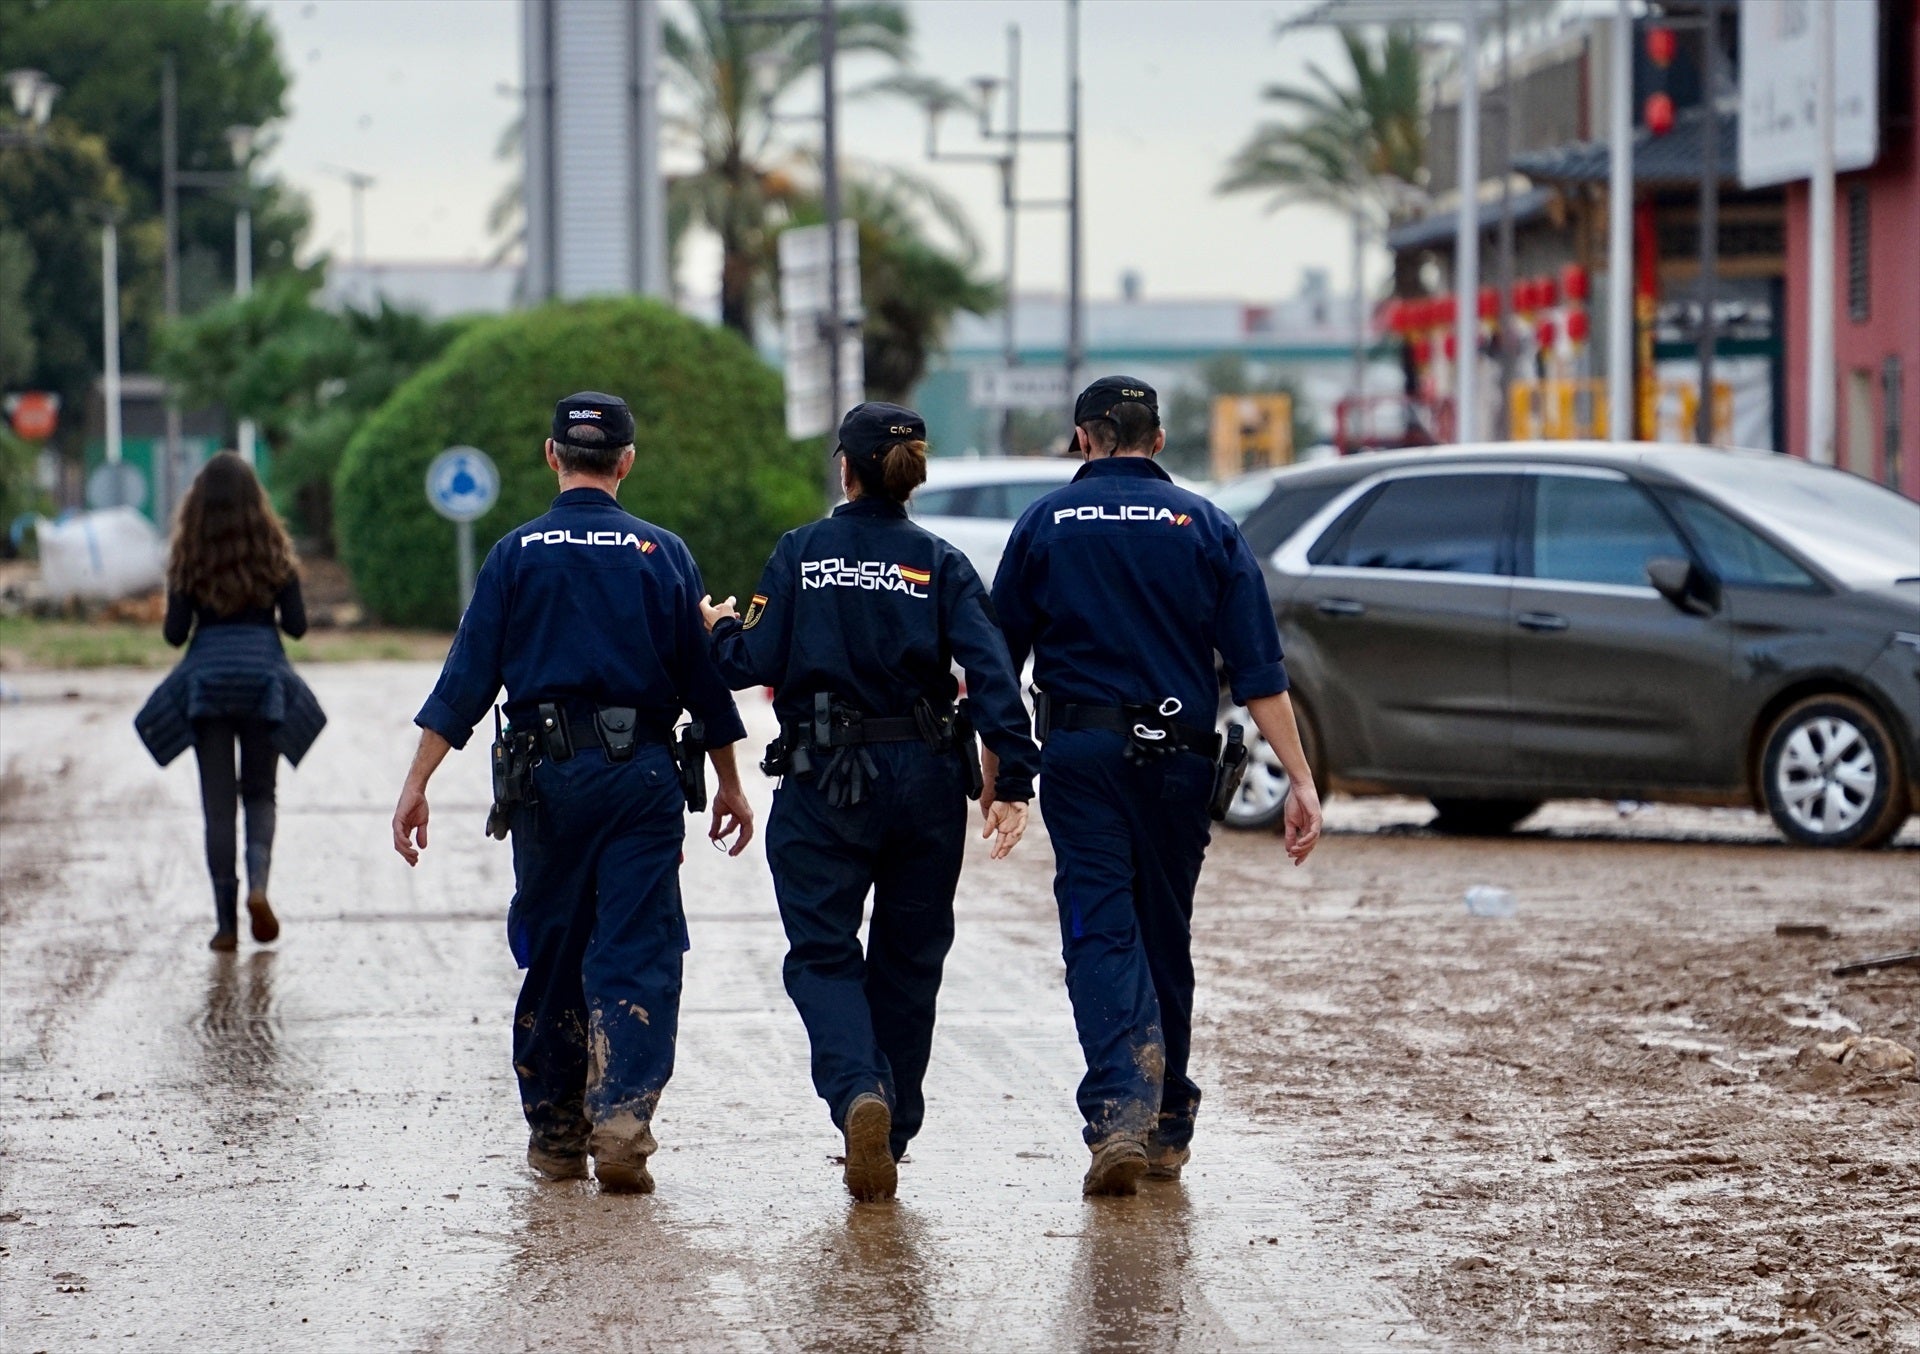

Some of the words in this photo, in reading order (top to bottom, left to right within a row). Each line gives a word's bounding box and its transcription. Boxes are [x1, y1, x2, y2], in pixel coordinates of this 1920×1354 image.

[1121, 388, 1145, 398] CNP
[1054, 505, 1176, 525] POLICIA
[521, 530, 641, 548] POLICIA
[801, 557, 903, 579] POLICIA
[803, 573, 928, 598] NACIONAL
